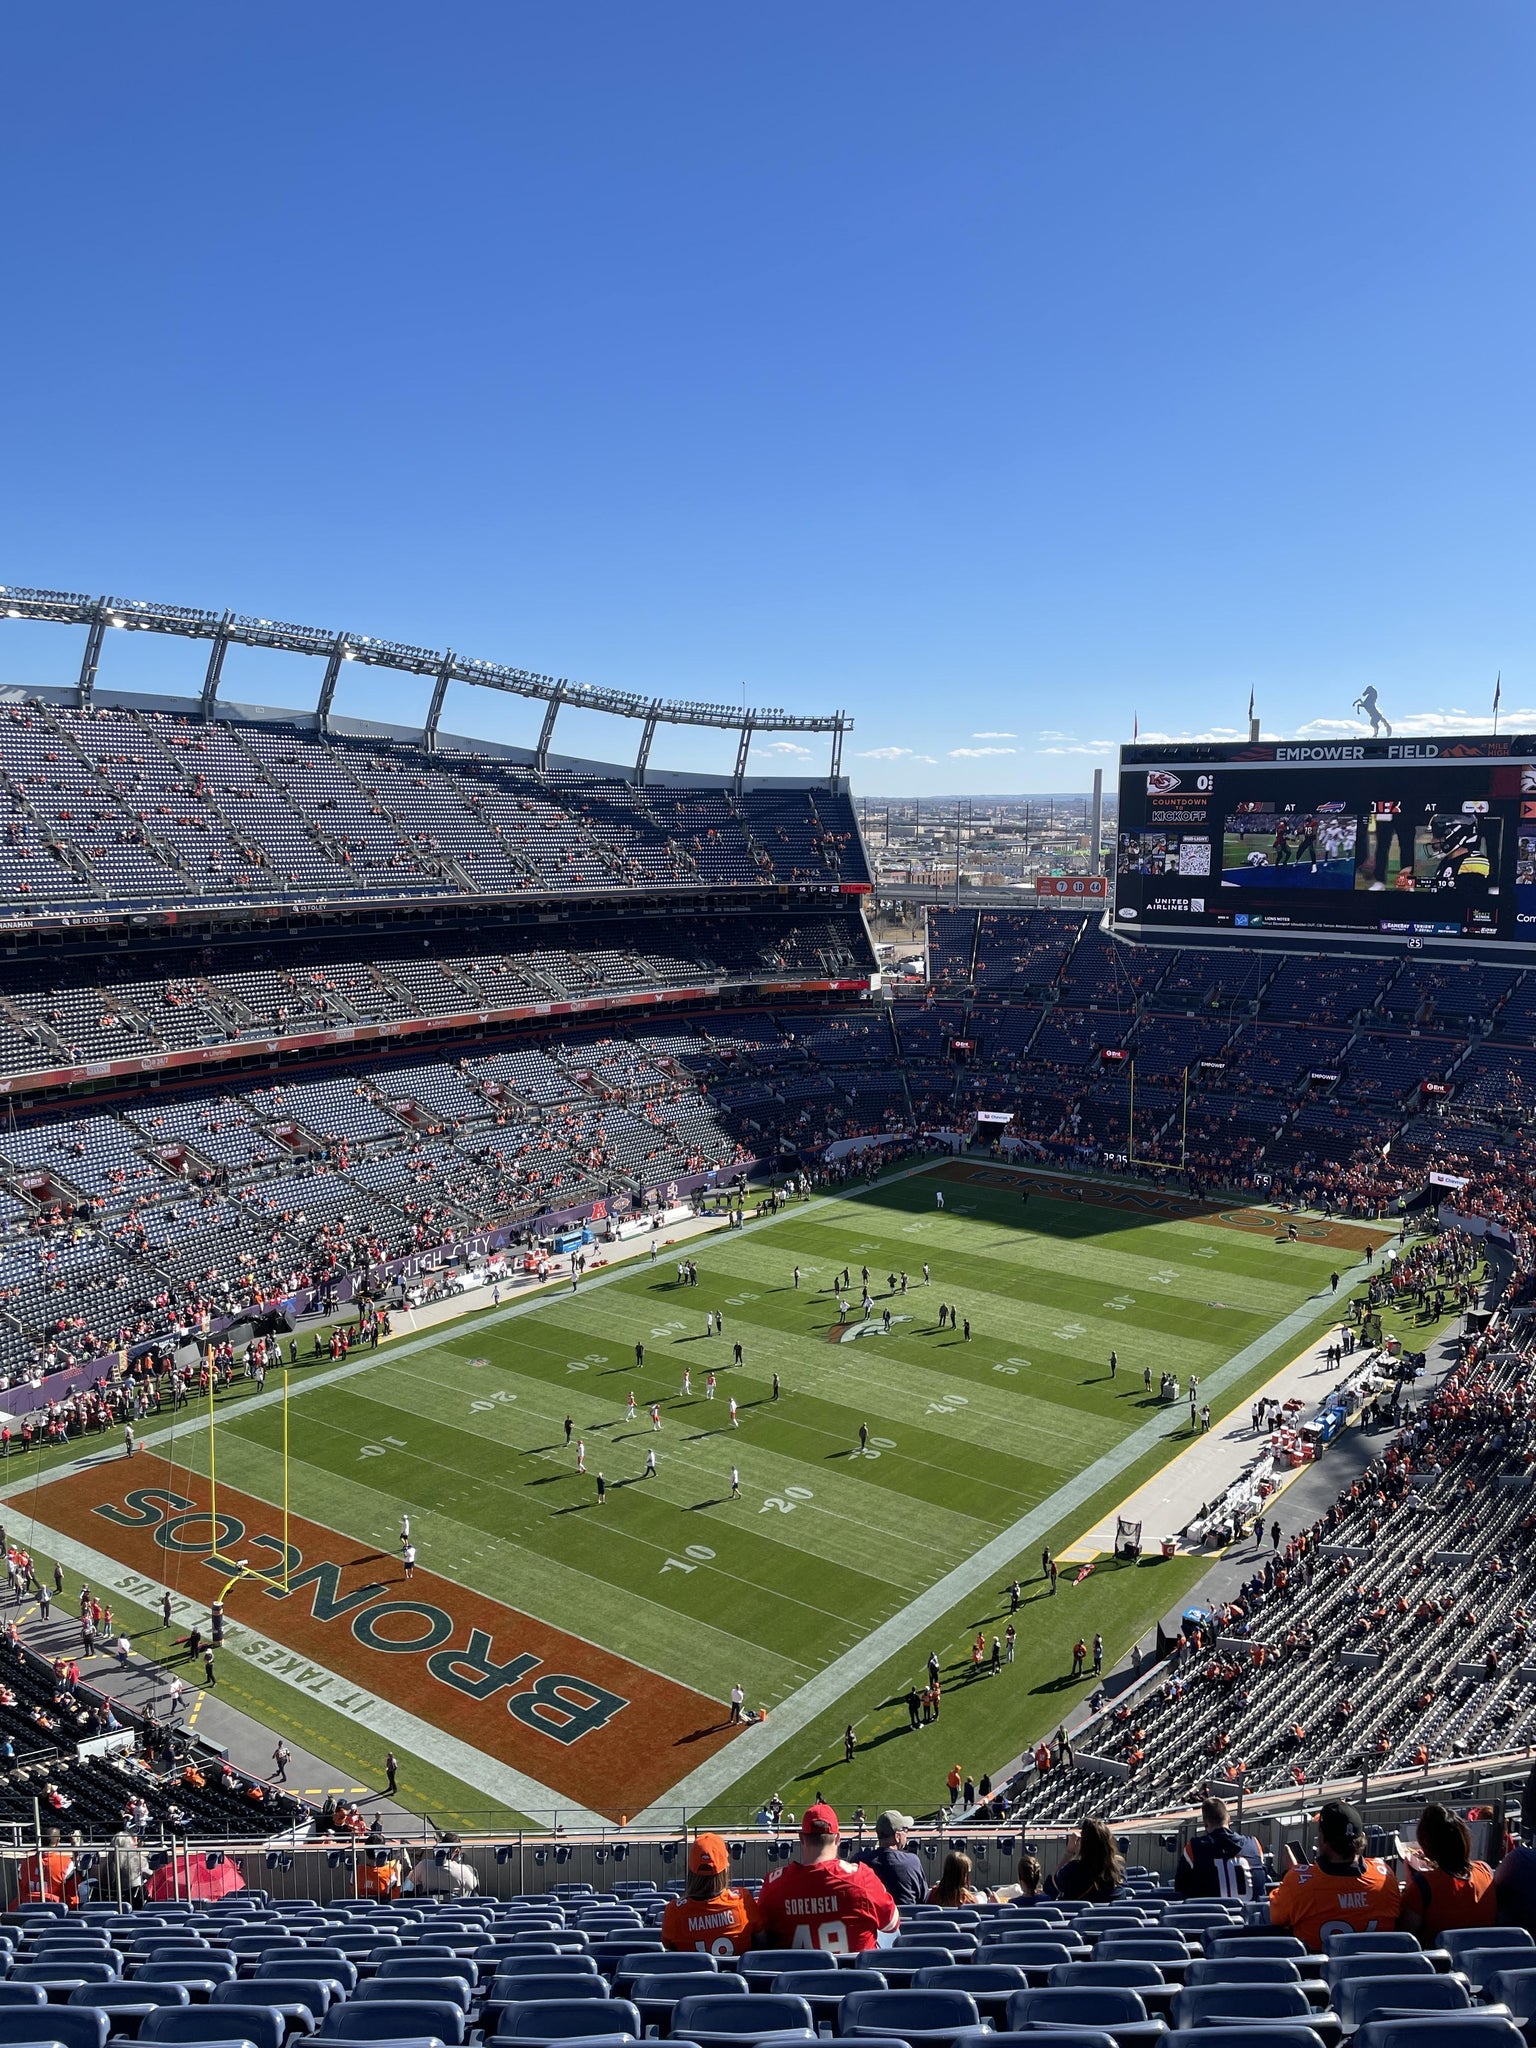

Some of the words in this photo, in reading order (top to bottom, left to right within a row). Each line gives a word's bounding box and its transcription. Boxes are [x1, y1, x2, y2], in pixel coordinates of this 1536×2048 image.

[1276, 746, 1364, 760] EMPOWER
[1388, 744, 1438, 759] FIELD
[1152, 811, 1206, 821] KICKOFF
[1284, 803, 1296, 812] AT
[1424, 803, 1437, 812] AT
[1409, 939, 1420, 947] 25
[967, 1171, 1333, 1238] BRONCOS
[1192, 1246, 1220, 1258] 10
[352, 1265, 394, 1295] ME
[402, 1249, 442, 1277] HIGH
[453, 1235, 491, 1257] CITY
[1148, 1270, 1180, 1284] 20
[725, 1292, 760, 1306] 50
[1103, 1295, 1136, 1311] 30
[652, 1321, 688, 1337] 40
[1053, 1323, 1088, 1340] 40
[566, 1354, 608, 1372] 30
[992, 1357, 1032, 1375] 50
[471, 1390, 517, 1411] 20
[931, 1395, 968, 1414] 40
[359, 1435, 408, 1457] 10
[854, 1437, 897, 1460] 30
[763, 1486, 814, 1514] 20
[667, 1545, 716, 1574] 10
[113, 1575, 156, 1597] US
[91, 1488, 631, 1747] BRONCOS
[241, 1640, 336, 1694] TAKES
[334, 1692, 376, 1714] IT
[1214, 1857, 1253, 1902] 10
[785, 1895, 838, 1916] SORENSEN
[1337, 1891, 1368, 1910] WARE
[688, 1910, 735, 1932] MANNING
